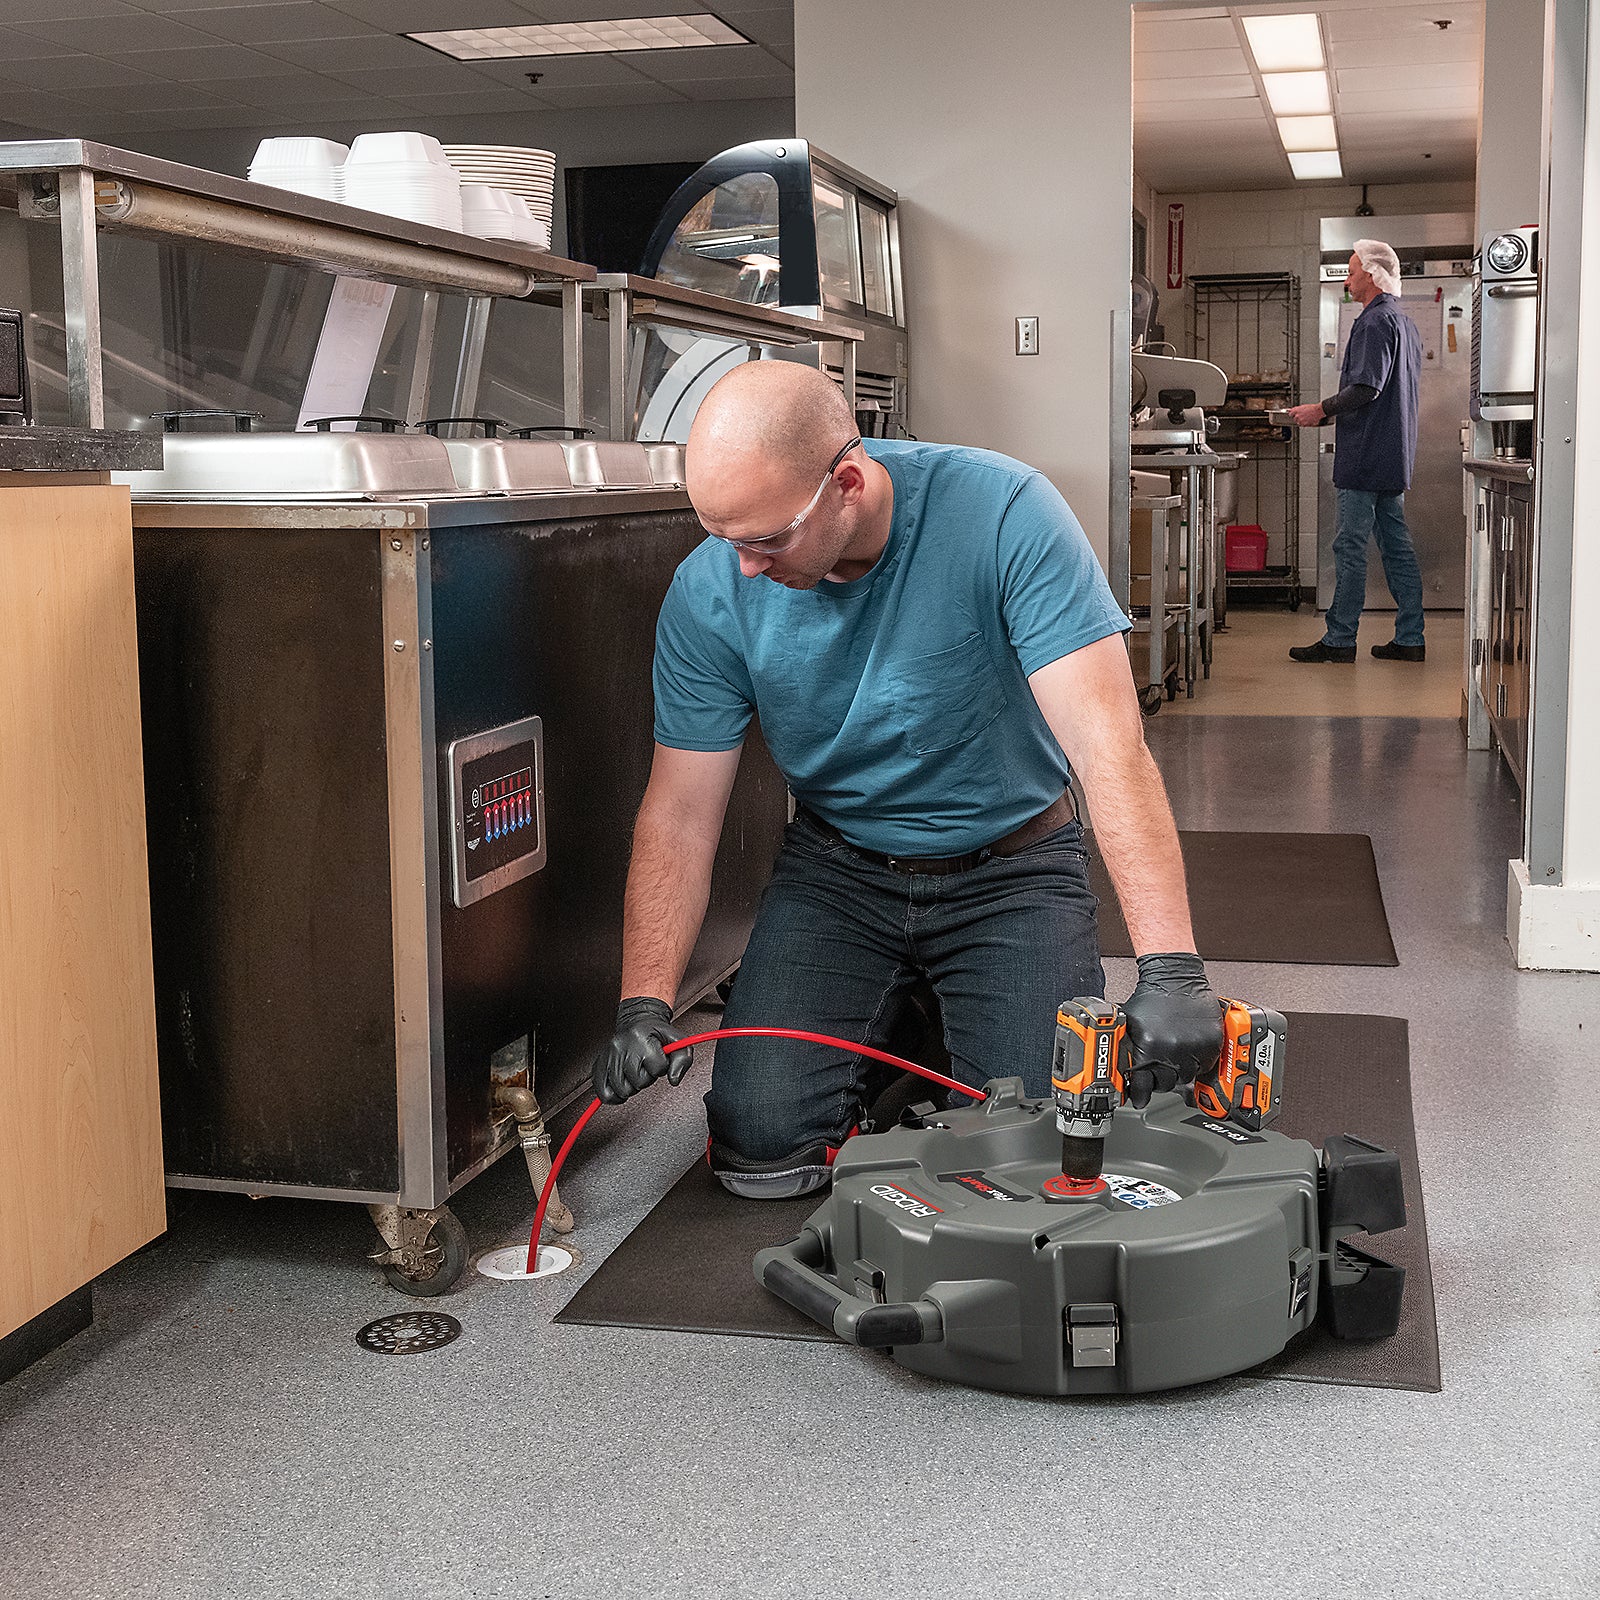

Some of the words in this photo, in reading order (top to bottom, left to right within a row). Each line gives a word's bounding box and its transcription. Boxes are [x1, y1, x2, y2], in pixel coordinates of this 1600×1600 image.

[1097, 1034, 1109, 1079] RIDGID
[1226, 1039, 1234, 1084] BRUSHLESS
[1259, 1044, 1267, 1067] 4.0Ah
[870, 1185, 937, 1218] RIDGID
